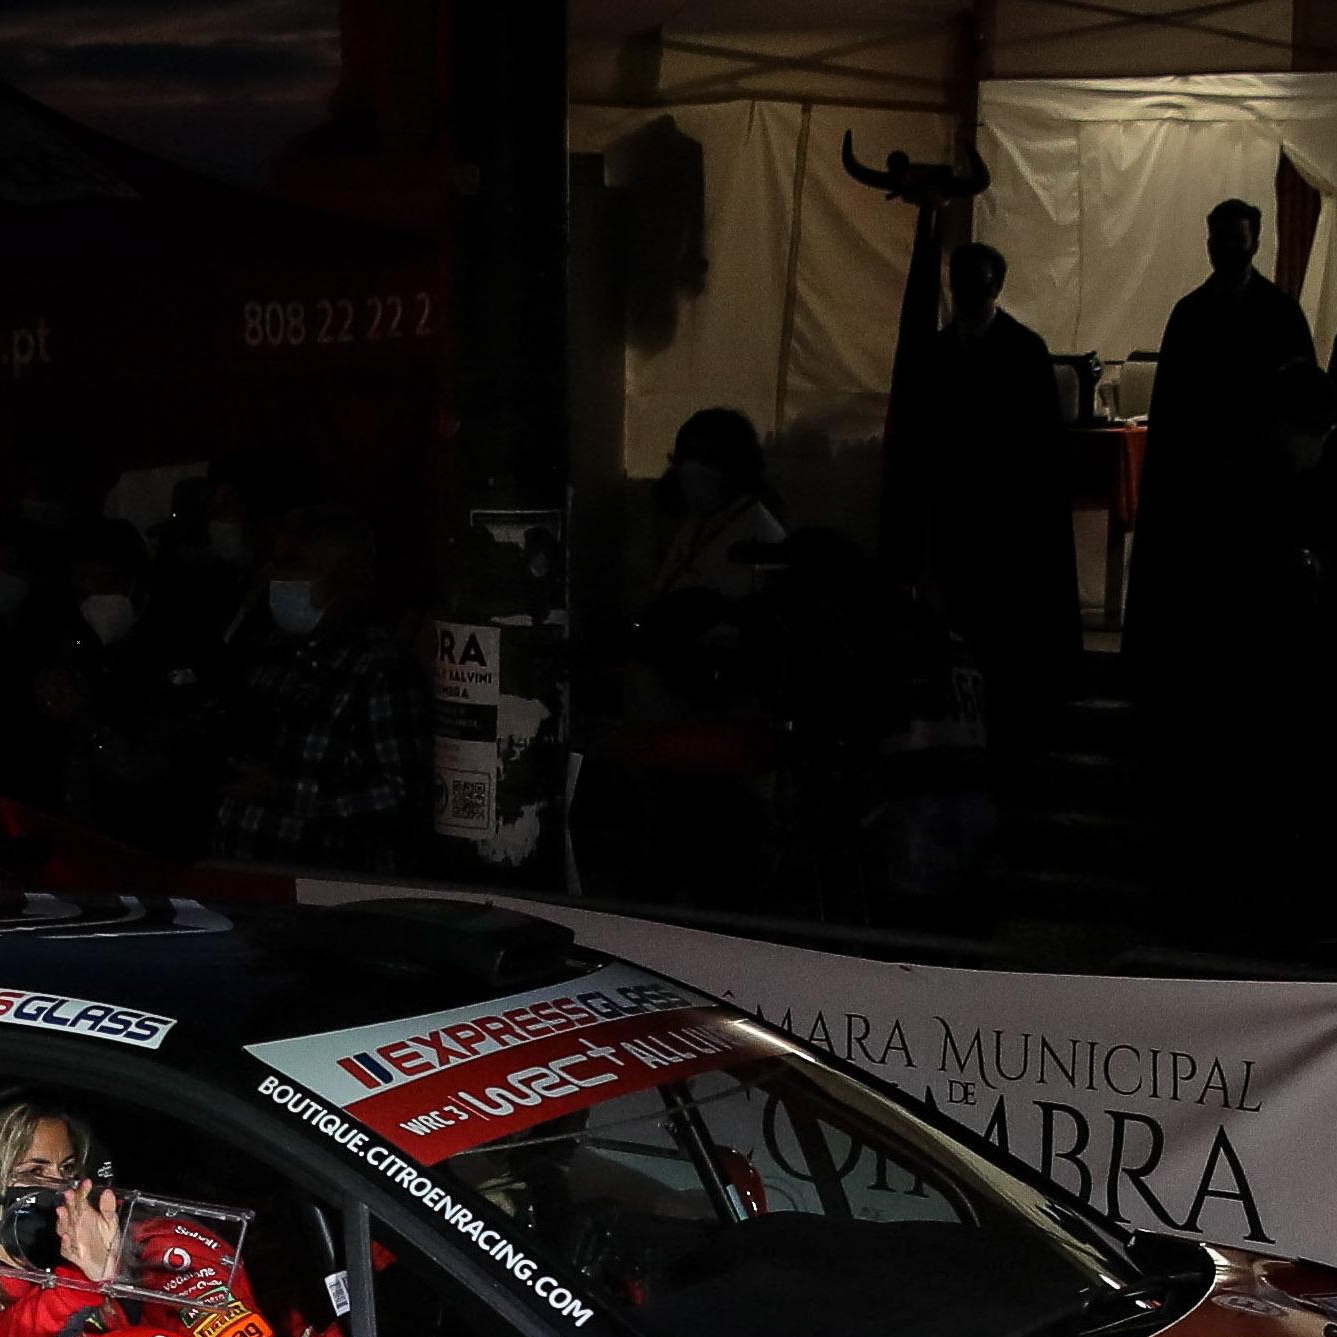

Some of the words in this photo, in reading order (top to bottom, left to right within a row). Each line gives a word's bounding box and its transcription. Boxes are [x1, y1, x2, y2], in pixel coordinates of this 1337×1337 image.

[242, 298, 306, 348] 808
[314, 297, 357, 344] 22
[366, 293, 405, 341] 22
[933, 1015, 1263, 1113] MUNICIPAL
[947, 1079, 977, 1106] DE
[399, 1106, 455, 1138] WRC
[446, 1103, 470, 1123] 3
[257, 1075, 594, 1328] BOUTIQUE.CITROENRACING.COM
